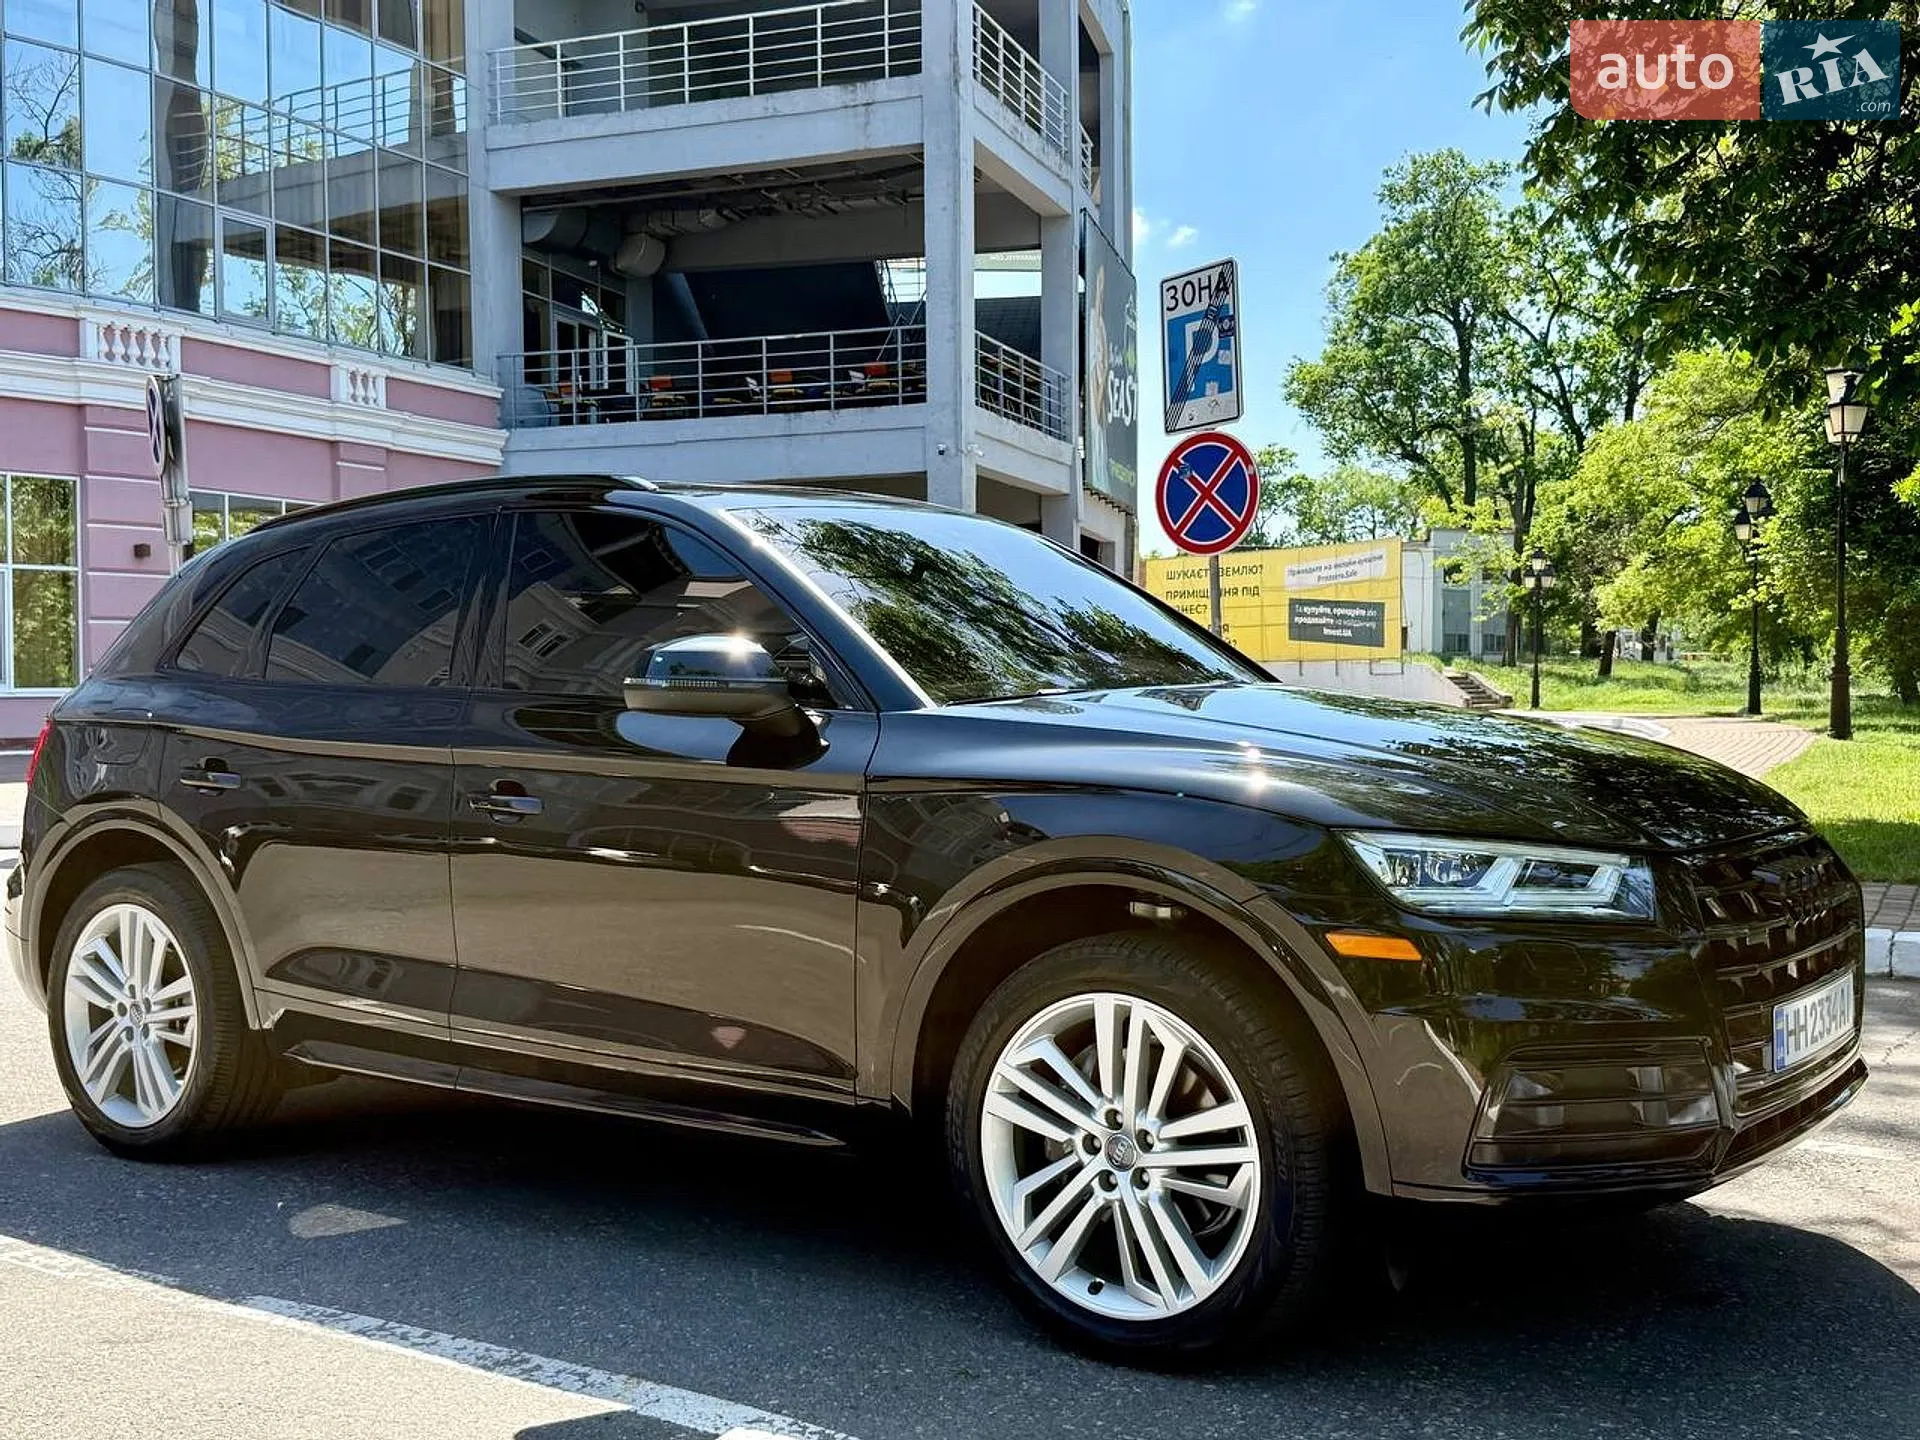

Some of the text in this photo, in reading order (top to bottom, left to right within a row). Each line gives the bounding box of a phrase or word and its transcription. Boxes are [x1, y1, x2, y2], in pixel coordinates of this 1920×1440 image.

[1165, 270, 1230, 312] ЗОНА
[1165, 586, 1260, 600] ПРИМІЩНЯ ПІД
